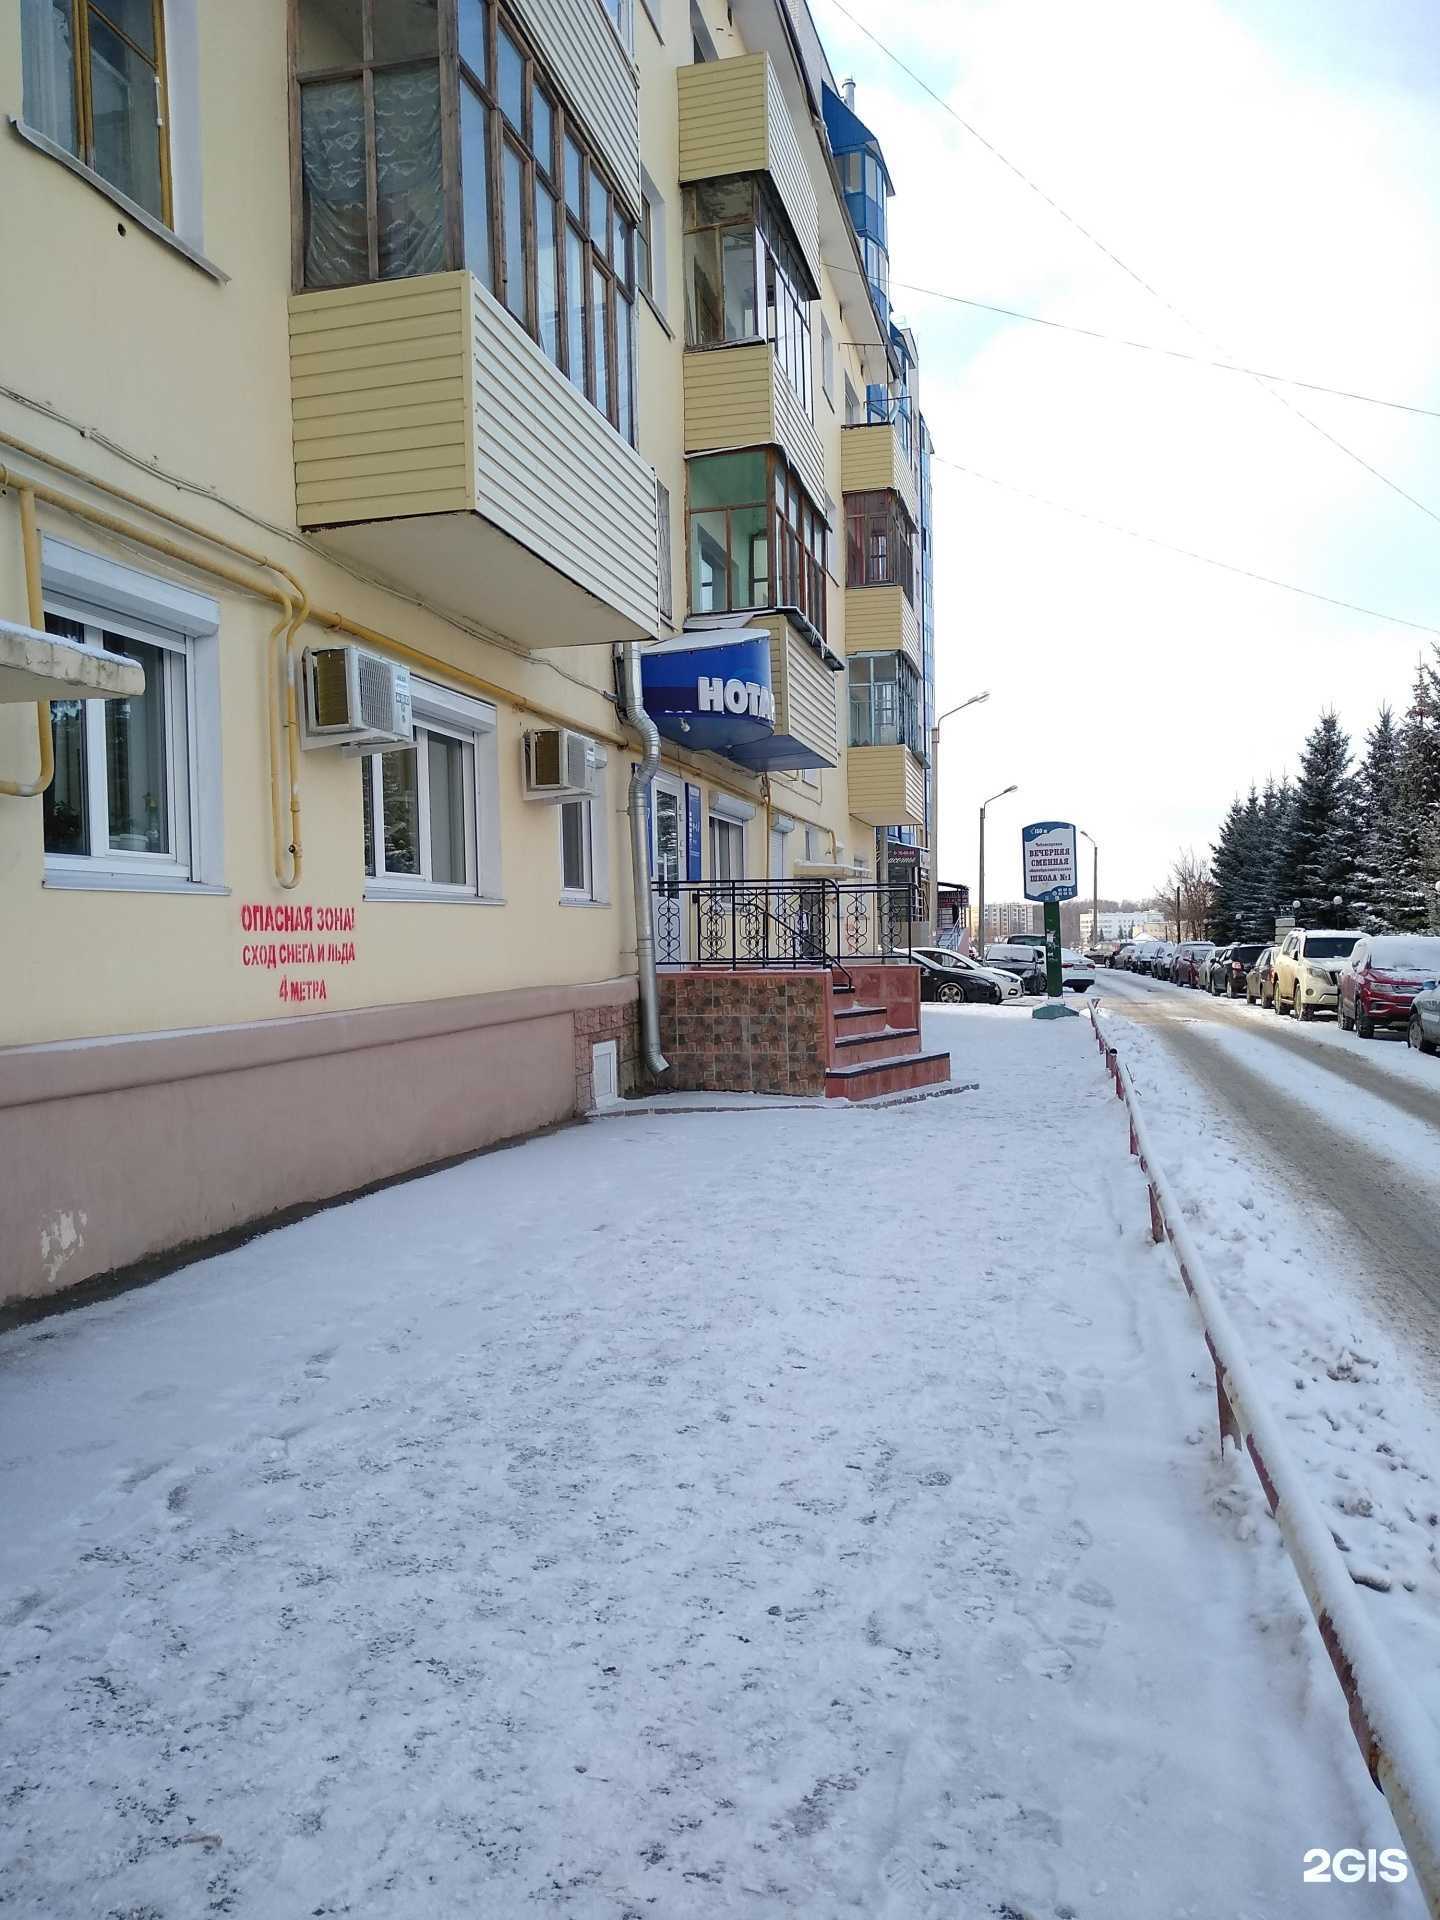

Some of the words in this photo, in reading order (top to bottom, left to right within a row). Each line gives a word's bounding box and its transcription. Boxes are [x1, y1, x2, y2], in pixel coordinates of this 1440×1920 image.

[697, 676, 775, 721] НОТА
[1029, 848, 1070, 857] ВЕЧЕРНЯЯ
[1031, 858, 1069, 867] СМЕННАЯ
[1030, 874, 1057, 882] ШКОЛА
[1060, 873, 1071, 881] №1
[241, 904, 313, 932] ОПАСНАЯ
[316, 906, 355, 931] ЗОНА!
[242, 944, 277, 968] СХОД
[279, 943, 315, 964] СНЕГА
[317, 943, 325, 962] И
[327, 942, 356, 964] ЛЬДА
[279, 975, 288, 1001] 4
[290, 979, 327, 1001] МЕТРА
